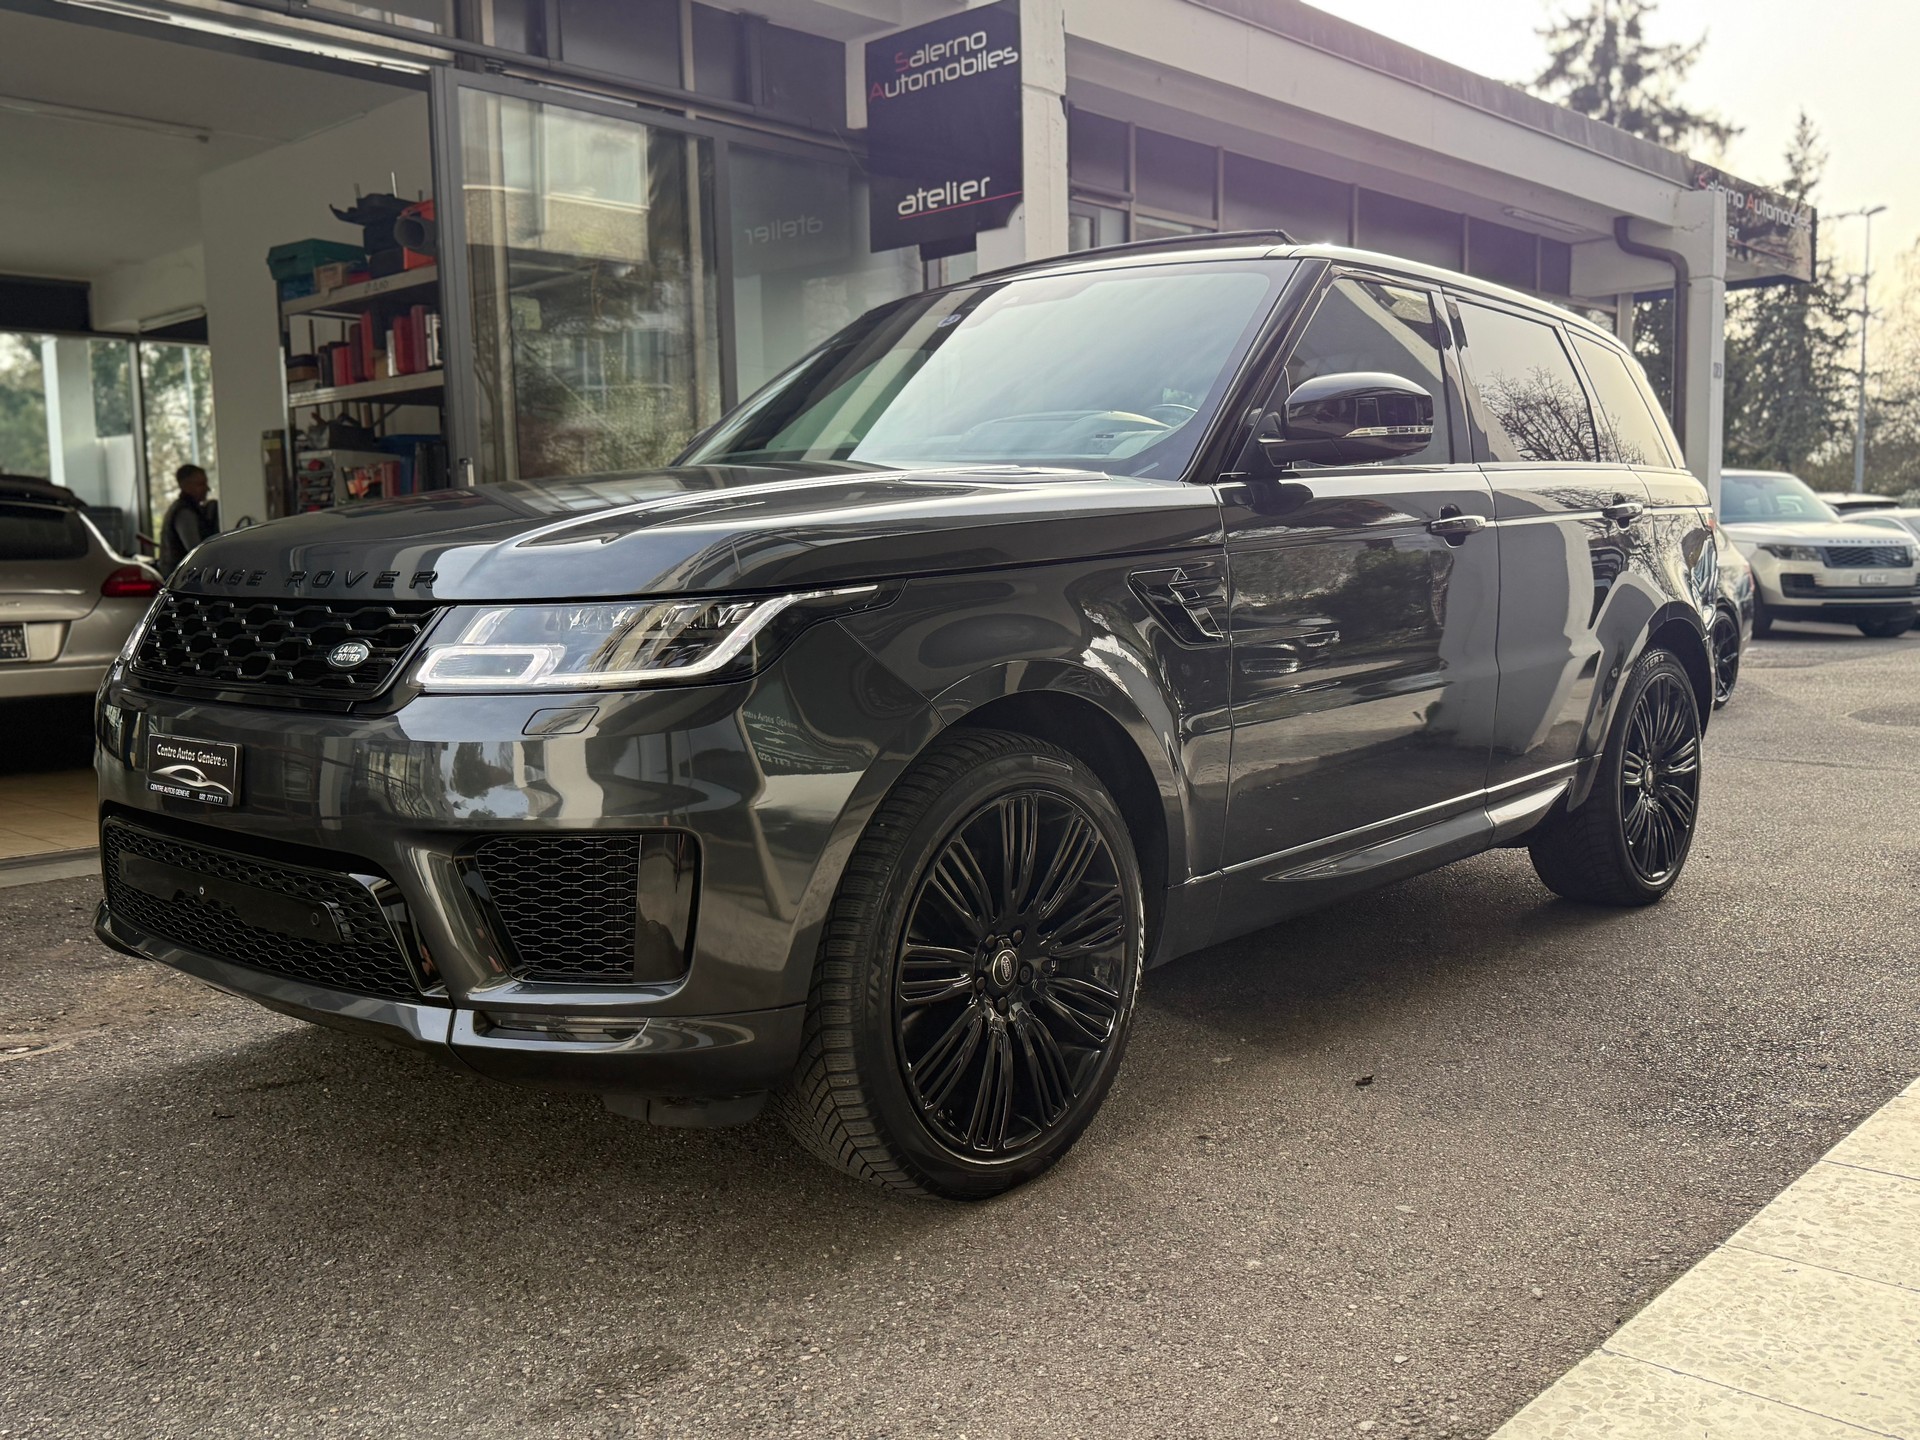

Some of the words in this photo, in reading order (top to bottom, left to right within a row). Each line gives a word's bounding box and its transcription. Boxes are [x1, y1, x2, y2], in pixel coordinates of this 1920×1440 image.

[895, 30, 987, 73] Salerno
[868, 46, 1019, 102] Automobiles
[897, 176, 991, 215] atelier
[181, 567, 268, 587] RANGE
[284, 570, 439, 590] ROVER
[156, 744, 176, 758] Centre
[177, 747, 195, 761] Autos
[197, 751, 221, 766] Genève
